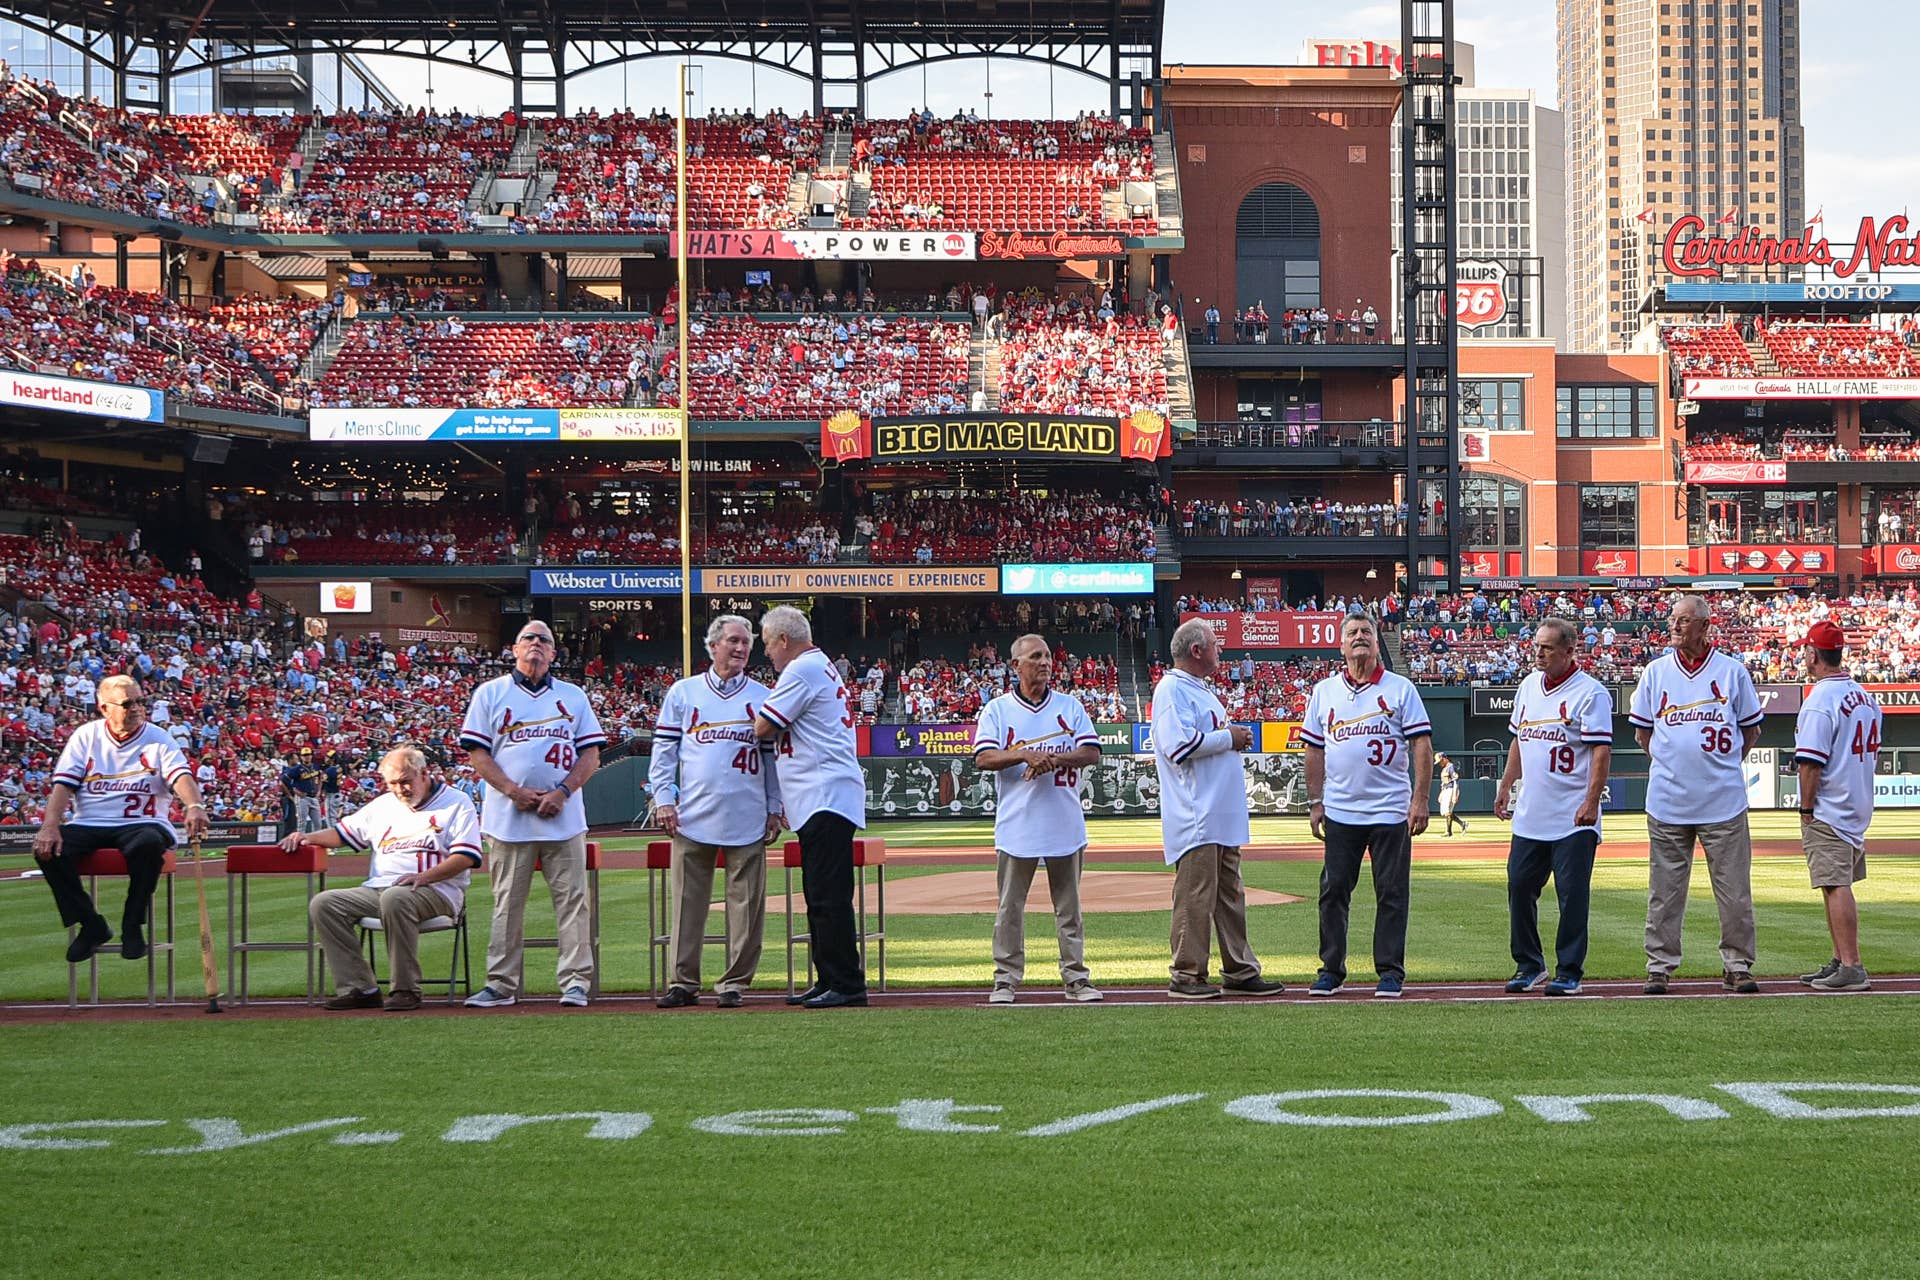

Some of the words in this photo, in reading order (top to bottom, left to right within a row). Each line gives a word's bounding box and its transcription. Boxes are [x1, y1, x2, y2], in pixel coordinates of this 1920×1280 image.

[1314, 41, 1443, 74] Hilt
[688, 234, 753, 255] HAT'S
[762, 235, 776, 255] A
[826, 238, 936, 252] POWER
[1001, 232, 1047, 259] Louis
[1050, 231, 1123, 257] Cardinals
[1664, 215, 1835, 278] Cardinals
[405, 276, 453, 285] TRIPLE
[460, 276, 485, 285] PLA
[1456, 267, 1497, 280] ILLIPS
[1456, 287, 1496, 316] 66
[1804, 285, 1893, 300] ROOFTOP
[13, 381, 93, 405] heartland
[1755, 381, 1792, 395] Cardinals
[1797, 382, 1831, 394] HALL
[1833, 382, 1842, 394] of
[1844, 382, 1878, 394] FAME
[877, 424, 942, 455] BIG
[946, 421, 1024, 453] MAC
[1028, 422, 1116, 455] LAND
[672, 458, 722, 472] BWTIE
[725, 460, 751, 472] BAR
[545, 573, 605, 588] Webster
[717, 574, 791, 587] FLEXIBILITY
[806, 574, 893, 587] CONVENIENCE
[908, 574, 986, 587] EXPERIENCE
[1050, 571, 1145, 588] @cardinals
[1481, 580, 1519, 589] BEVERAGES
[1616, 577, 1629, 588] TOP
[589, 600, 641, 610] SPORTS
[1242, 624, 1279, 633] Cardinal
[1242, 632, 1279, 641] Glennon
[1875, 692, 1920, 705] RINA
[1665, 705, 1725, 726] Cardinals
[509, 721, 570, 743] Cardinals
[919, 729, 970, 745] planet
[1099, 730, 1128, 745] ank
[1333, 720, 1391, 742] Cardinals
[1519, 720, 1568, 742] Cardinals
[1700, 726, 1732, 754] 36
[1851, 718, 1880, 762] 44
[545, 742, 573, 771] 48
[1022, 741, 1072, 755] ardinals
[1367, 739, 1398, 766] 37
[731, 746, 760, 776] 40
[1549, 746, 1575, 774] 19
[87, 773, 152, 795] Cardinals
[1054, 766, 1078, 788] 26
[124, 793, 158, 818] 24
[382, 834, 435, 854] Cardinals
